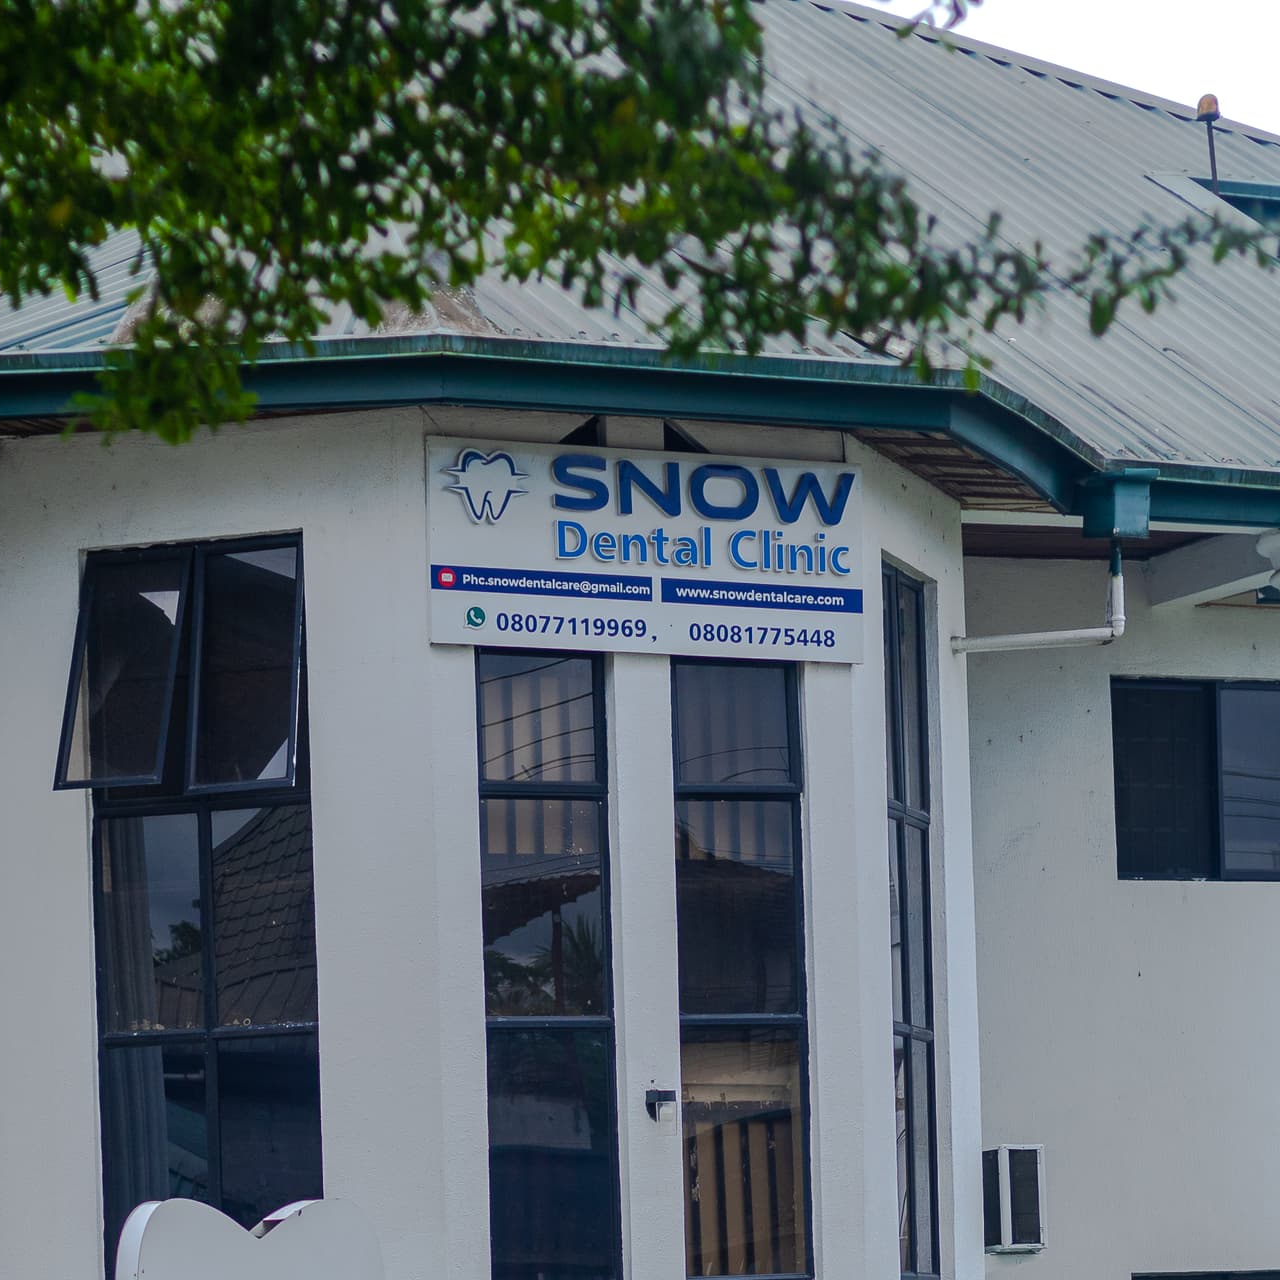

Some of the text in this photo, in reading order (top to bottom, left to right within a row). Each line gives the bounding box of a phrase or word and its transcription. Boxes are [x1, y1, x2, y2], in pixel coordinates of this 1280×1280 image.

[551, 454, 856, 526] SNOW
[555, 520, 851, 574] Dental Clinic
[462, 574, 845, 607] Phc.snowdentalcare@gmail.com www.snowdentalcare.com
[689, 623, 836, 648] 08081775448
